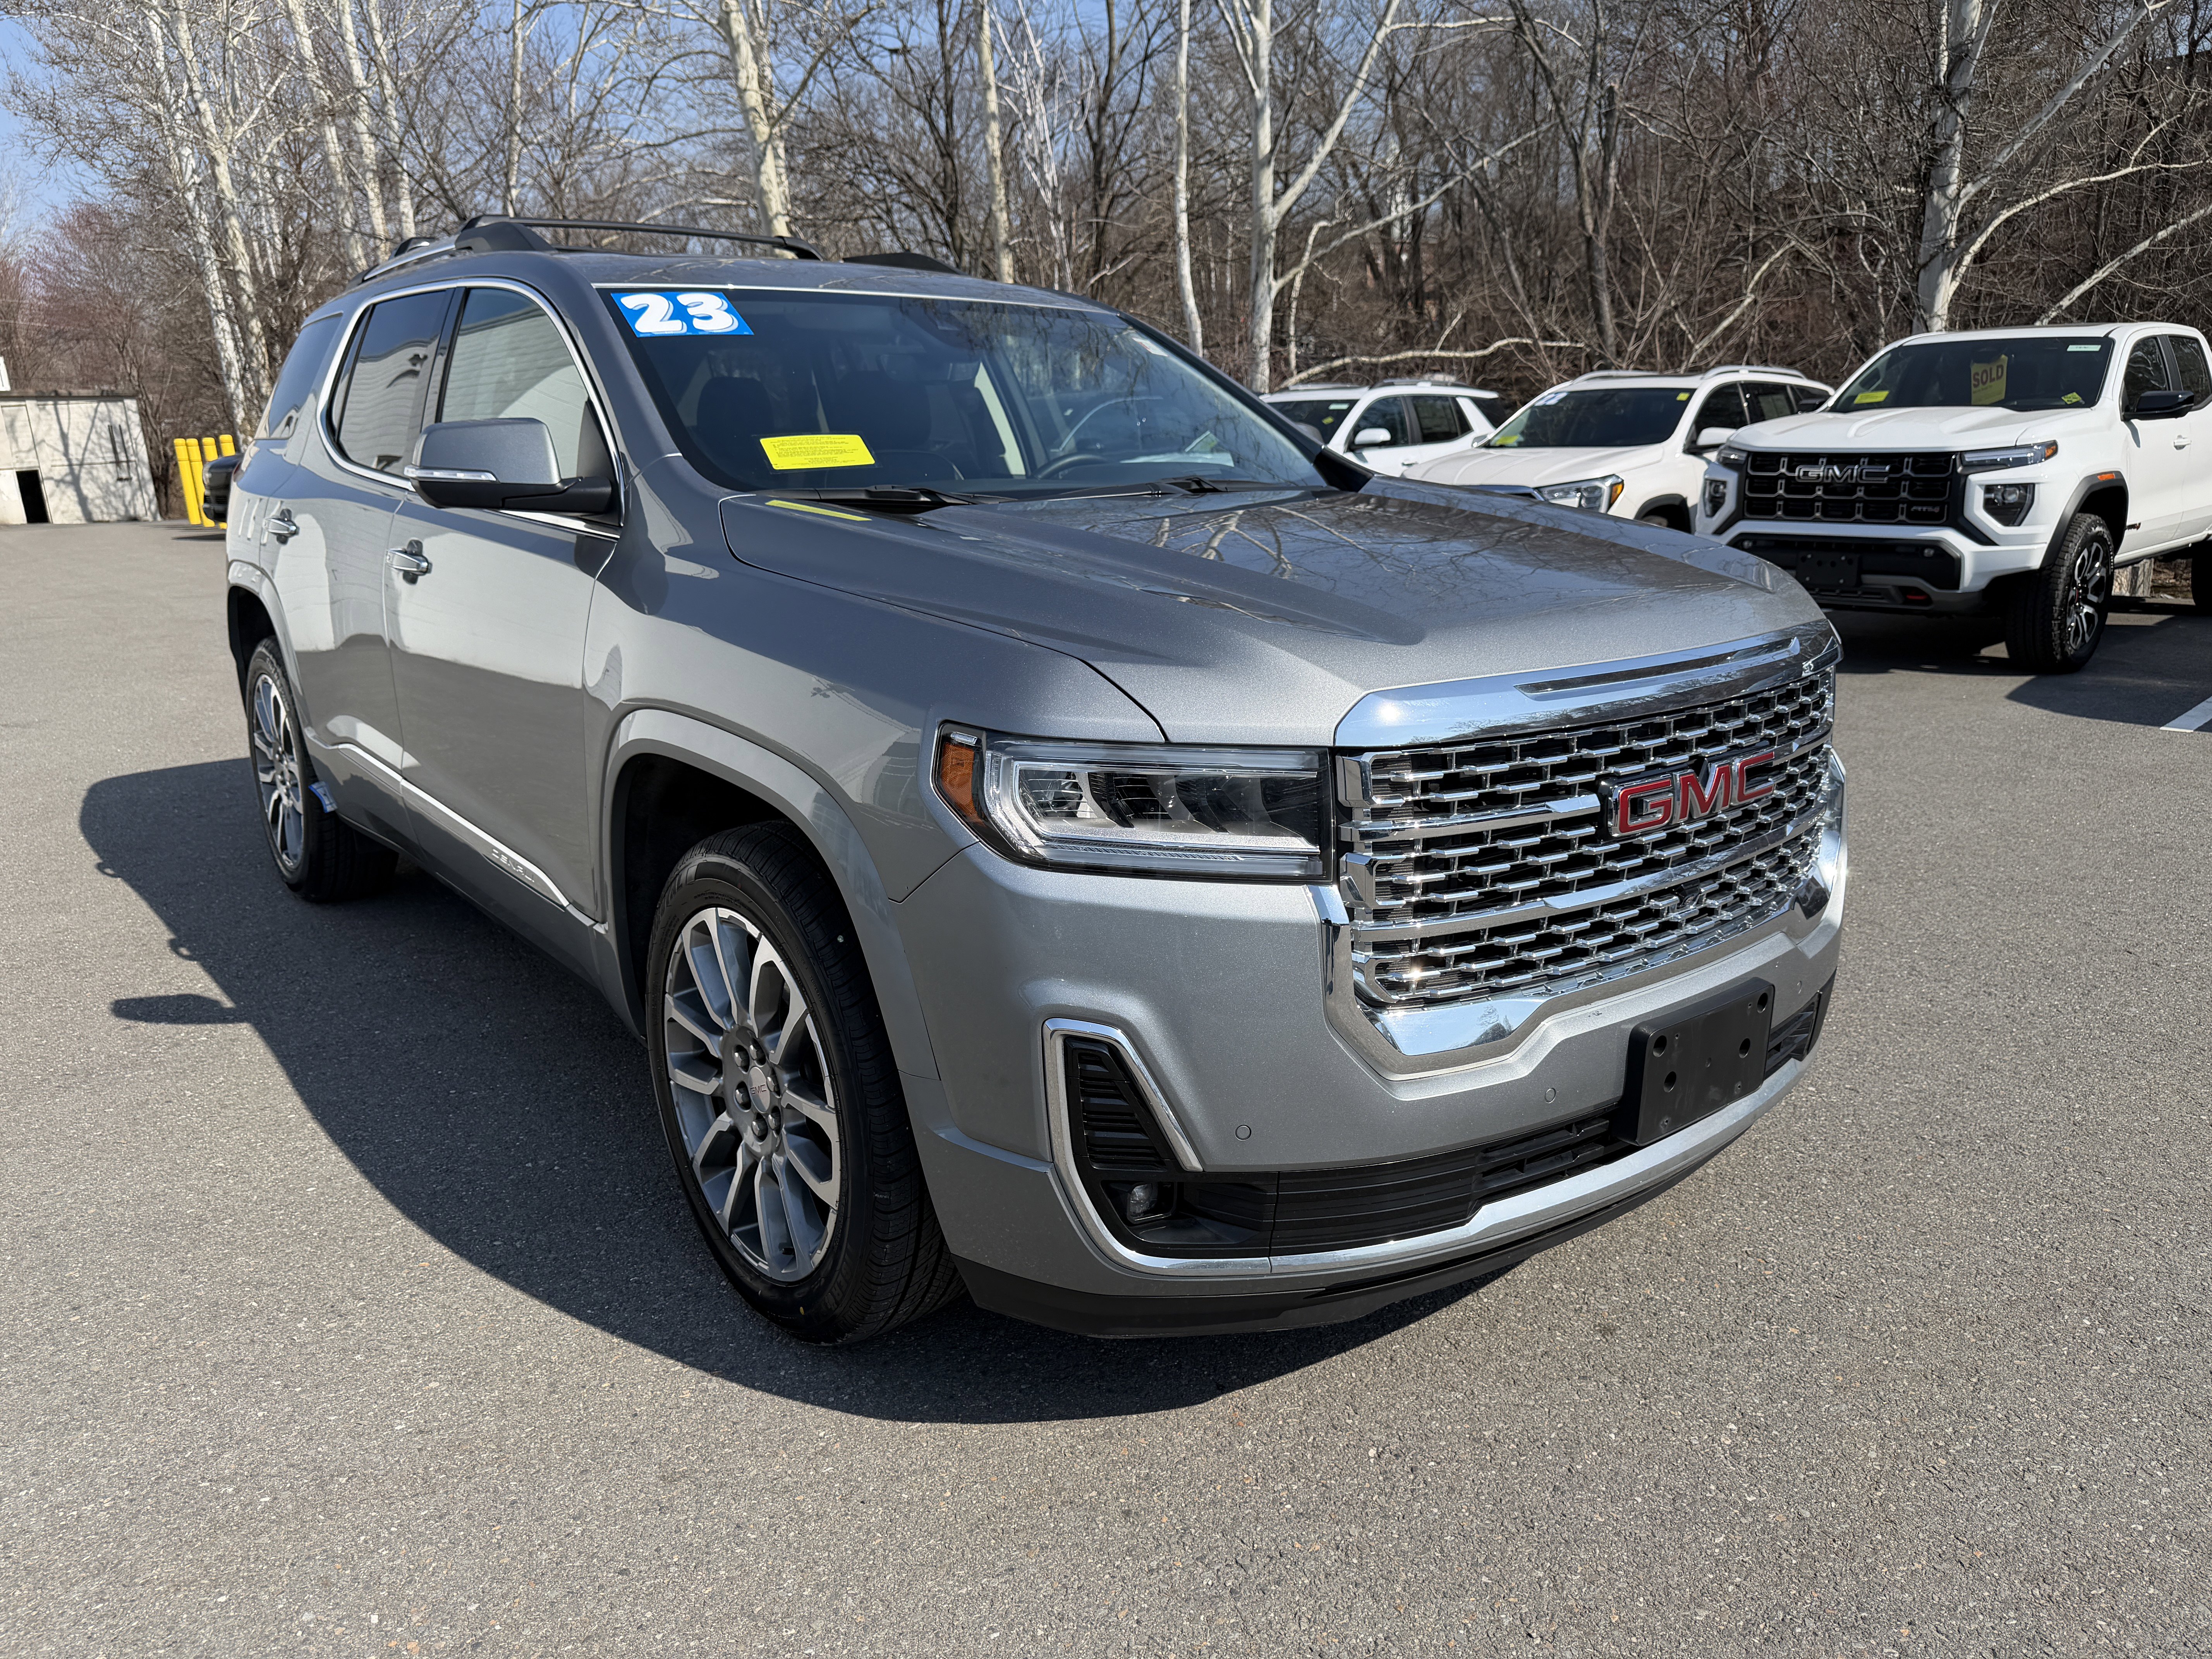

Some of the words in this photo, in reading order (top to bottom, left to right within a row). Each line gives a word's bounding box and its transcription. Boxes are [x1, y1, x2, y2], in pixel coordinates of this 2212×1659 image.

[621, 293, 738, 334] 23
[1973, 364, 2004, 388] SOLD
[1795, 465, 1891, 484] GMC
[1613, 750, 1775, 836] GMC
[750, 1084, 767, 1095] GMC
